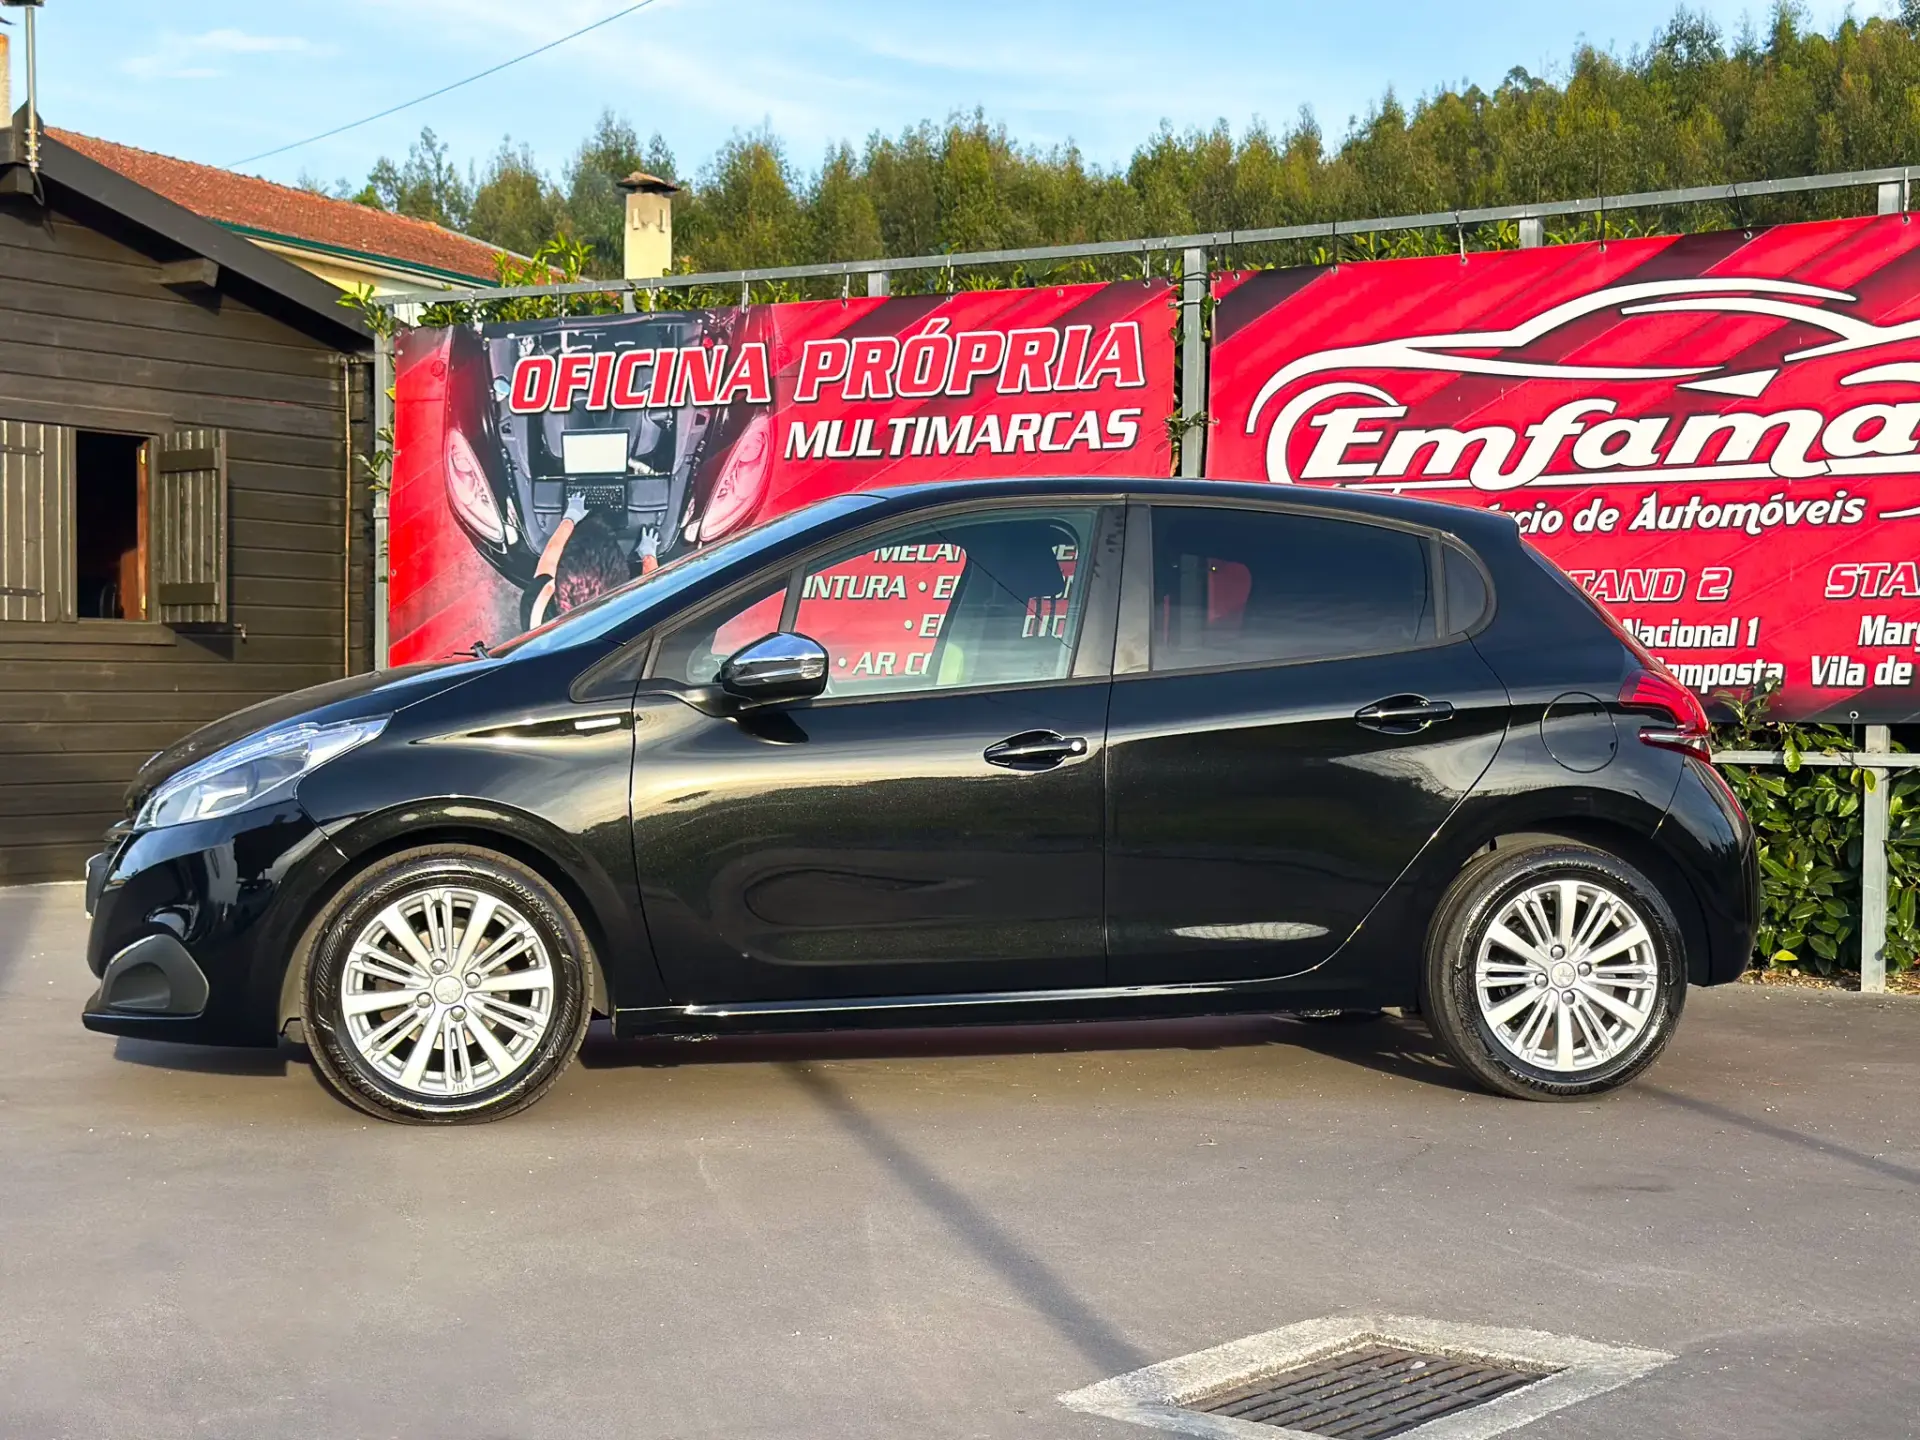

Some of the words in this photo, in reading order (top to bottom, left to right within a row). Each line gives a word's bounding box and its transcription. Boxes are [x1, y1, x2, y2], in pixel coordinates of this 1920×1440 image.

[509, 341, 771, 415] OFICINA
[793, 317, 1146, 403] PRÓPRIA
[783, 407, 1142, 460] MULTIMARCAS
[1298, 399, 1920, 490] Emfama
[1573, 498, 1620, 533] de
[801, 574, 907, 600] INTURA
[1564, 567, 1687, 602] TAND
[1696, 566, 1733, 601] 2
[1824, 561, 1920, 598] STA
[1746, 616, 1760, 647] 1
[851, 651, 897, 676] AR
[1655, 656, 1784, 695] omposta
[1810, 655, 1867, 687] Vila
[1873, 654, 1914, 687] de
